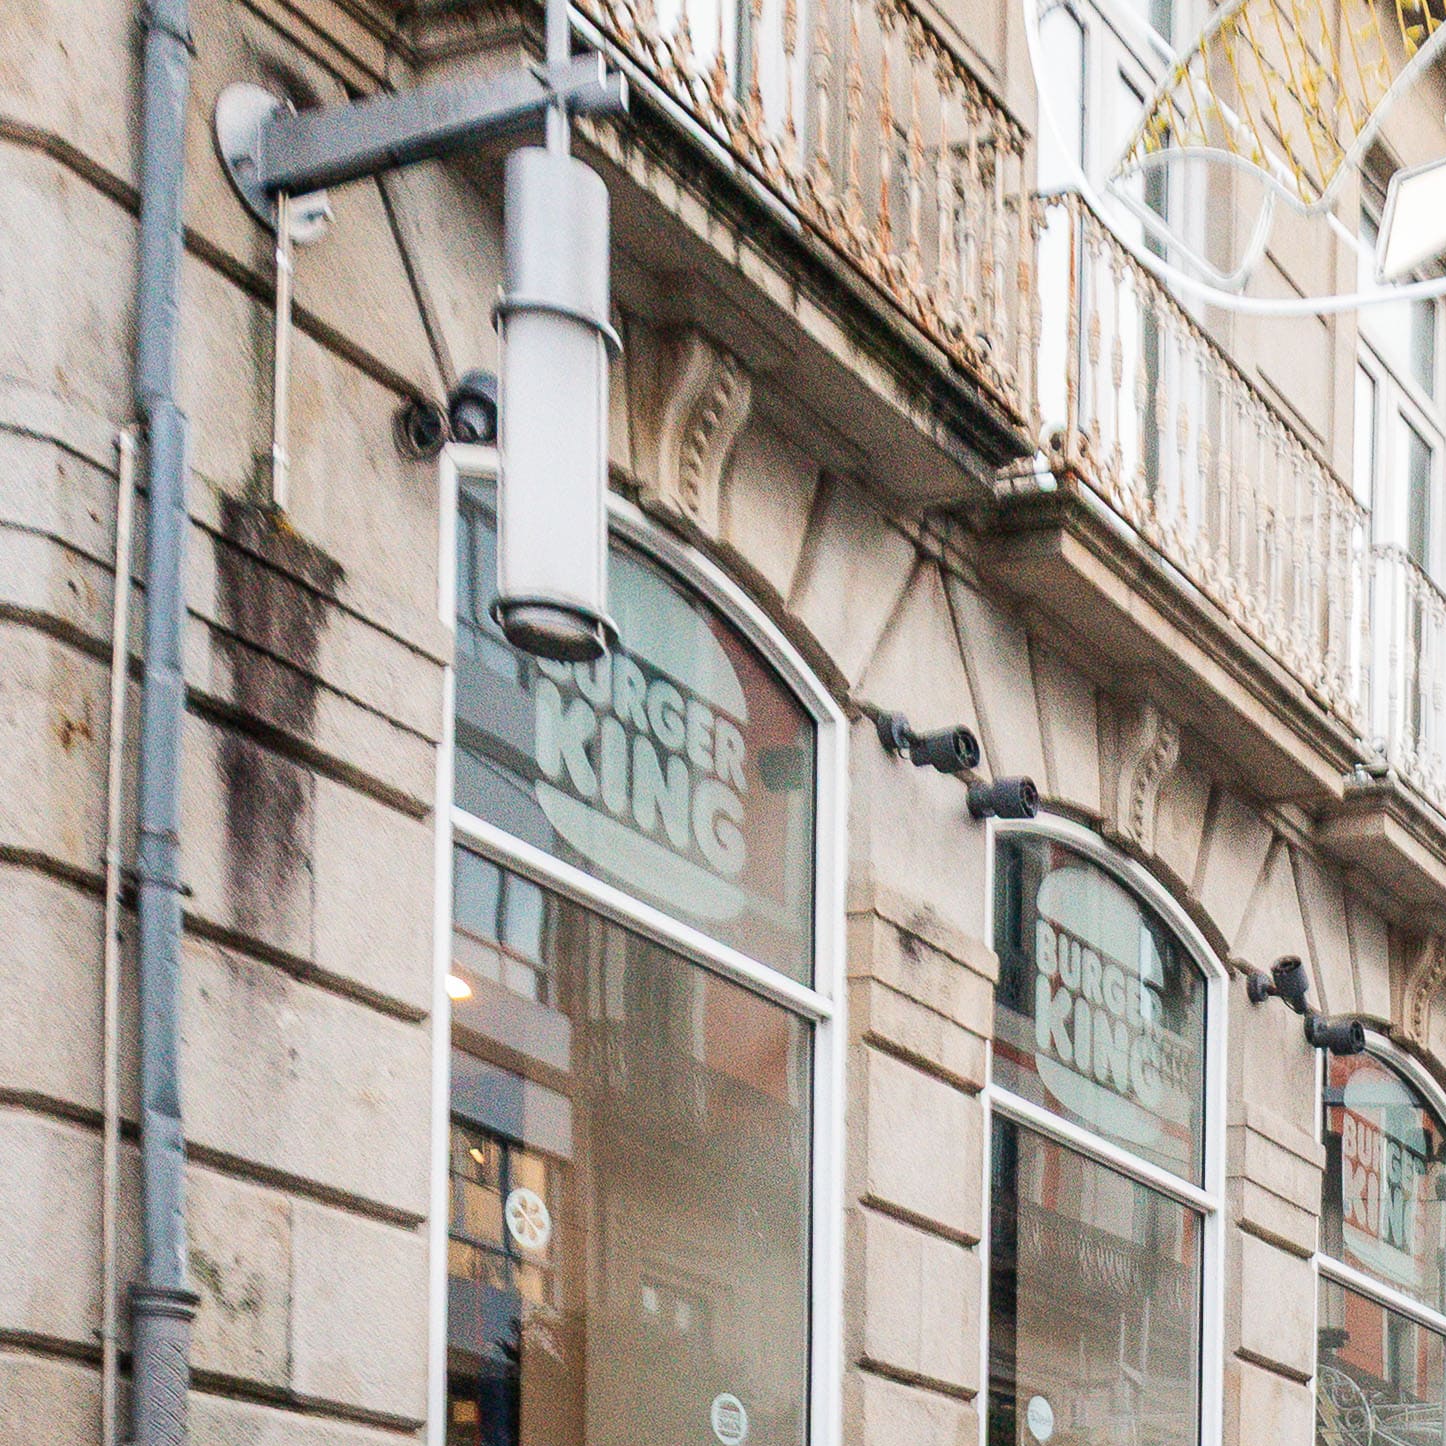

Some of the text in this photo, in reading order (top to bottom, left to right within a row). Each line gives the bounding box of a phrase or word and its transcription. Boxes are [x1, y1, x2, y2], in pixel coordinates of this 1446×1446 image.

[535, 676, 747, 876] KING
[1036, 918, 1163, 1030] BURGER
[1035, 973, 1162, 1106] KING
[1342, 1157, 1426, 1254] KIN
